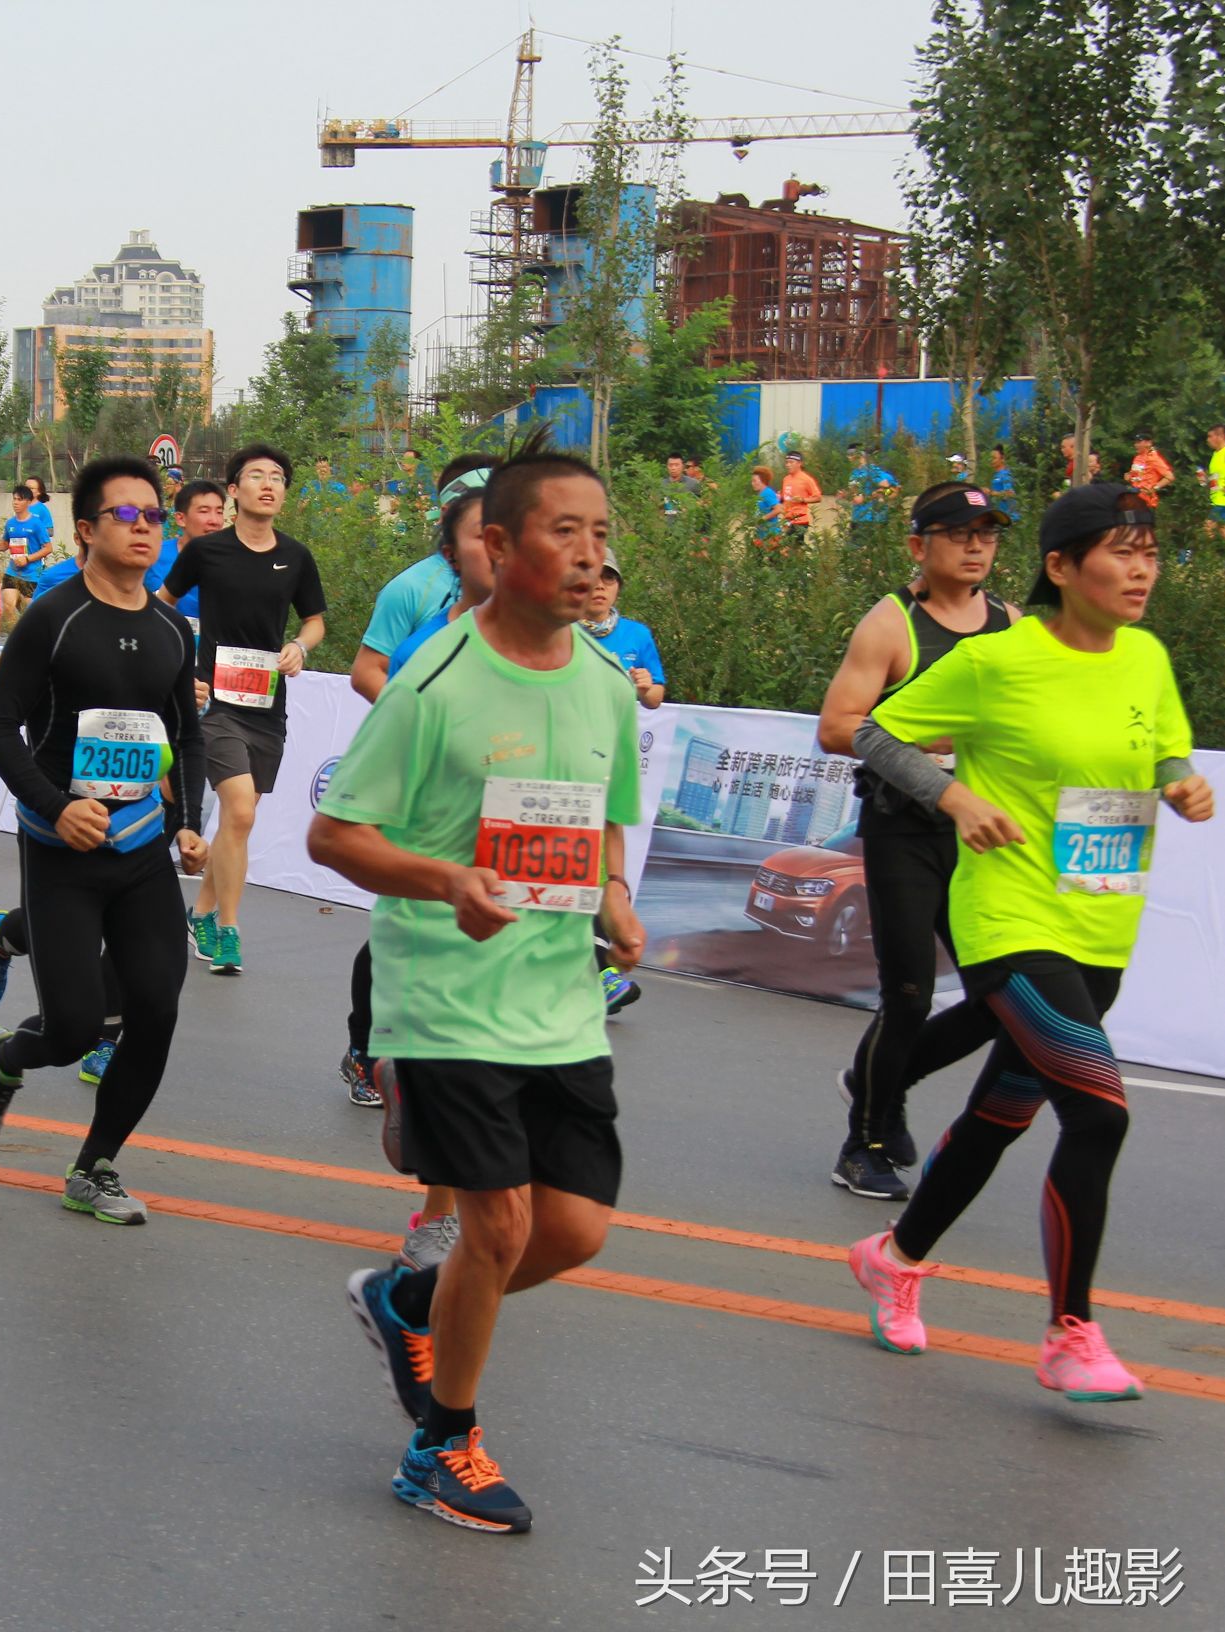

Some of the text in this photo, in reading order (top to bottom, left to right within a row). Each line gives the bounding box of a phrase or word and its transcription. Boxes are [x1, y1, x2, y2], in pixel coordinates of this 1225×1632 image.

[158, 447, 174, 467] 30
[80, 745, 155, 780] 23505
[519, 812, 562, 825] C-TREK
[489, 832, 591, 881] 10959
[1066, 832, 1134, 871] 25118
